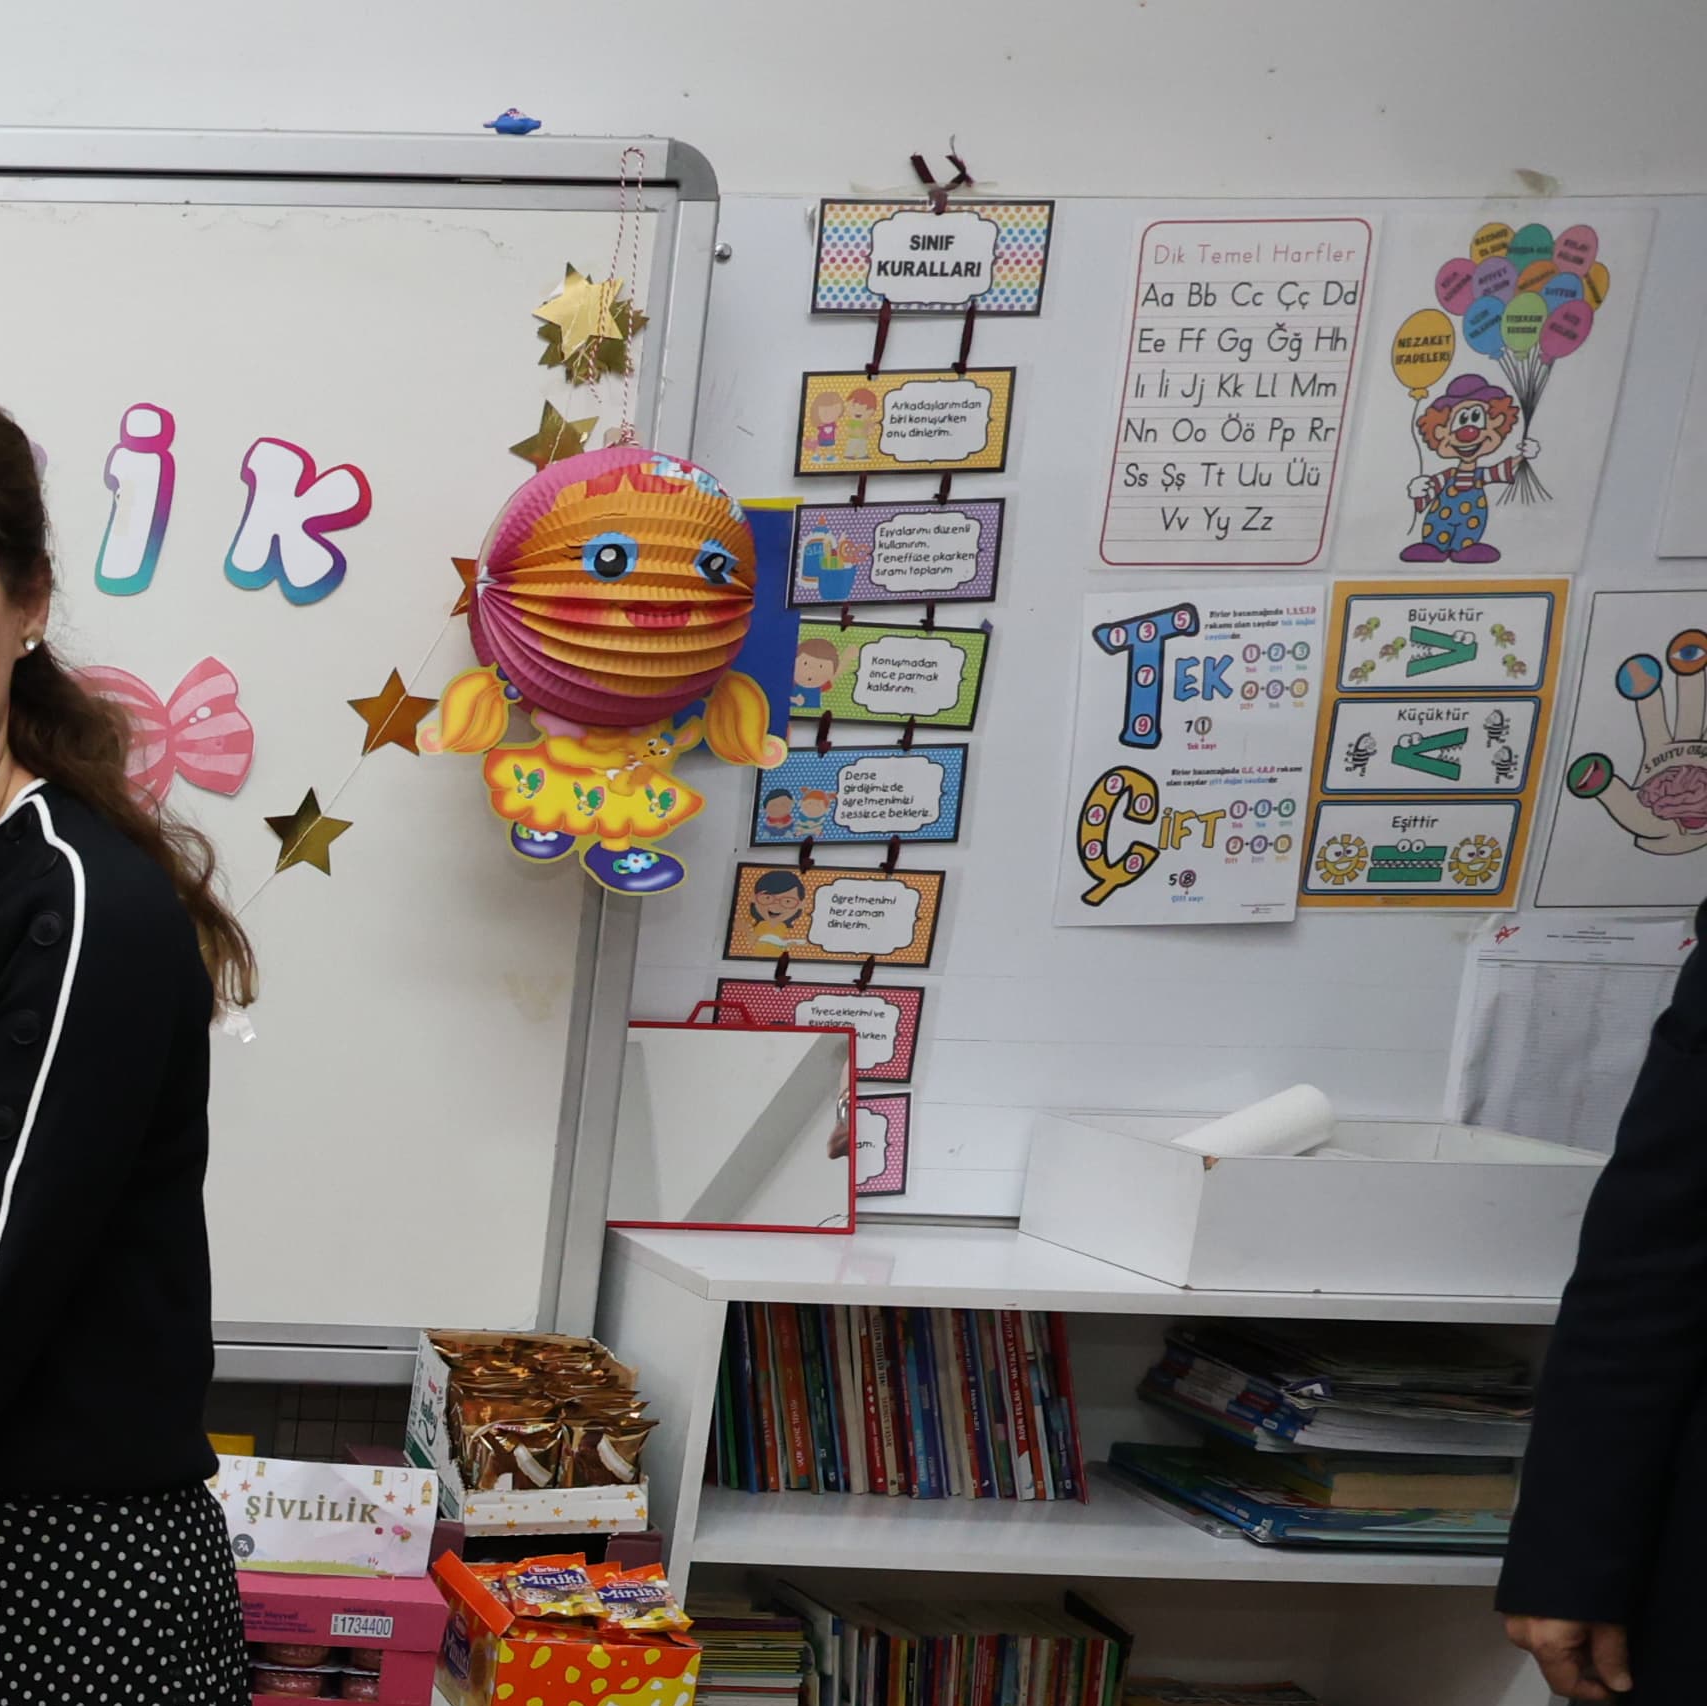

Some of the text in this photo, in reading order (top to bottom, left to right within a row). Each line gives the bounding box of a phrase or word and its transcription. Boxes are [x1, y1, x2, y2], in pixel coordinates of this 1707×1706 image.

[909, 235, 956, 252] SINIF
[1198, 242, 1356, 263] Temel Harfler
[876, 261, 982, 278] KURALLARI
[1141, 280, 1359, 311] Aa Bb Cc Çç Dd
[1138, 322, 1347, 362] Ee Ff Gg Ğğ Hh
[1397, 335, 1452, 348] NEZAKET
[1181, 373, 1206, 408] Jj
[1217, 372, 1245, 399] Kk
[1255, 372, 1277, 398] Ll
[1290, 372, 1337, 398] Mm
[1123, 413, 1336, 452] Nn Oo Öö Pp Rr
[1124, 457, 1321, 493] Ss Şş Tt Uu Üü
[1161, 507, 1274, 541] Vv Yy Zz
[1176, 613, 1187, 627] 5
[1407, 608, 1484, 626] Büyüktür
[1113, 629, 1121, 643] 1
[1143, 624, 1152, 638] 3
[1141, 669, 1150, 684] 7
[1397, 707, 1470, 726] Küçüktür
[1137, 718, 1148, 733] 9
[1391, 816, 1439, 833] Eşittir
[245, 1491, 380, 1524] ŞİVLİLİK
[519, 1569, 585, 1586] Miniki
[597, 1584, 664, 1601] Miniki
[339, 1617, 391, 1636] 1734400
